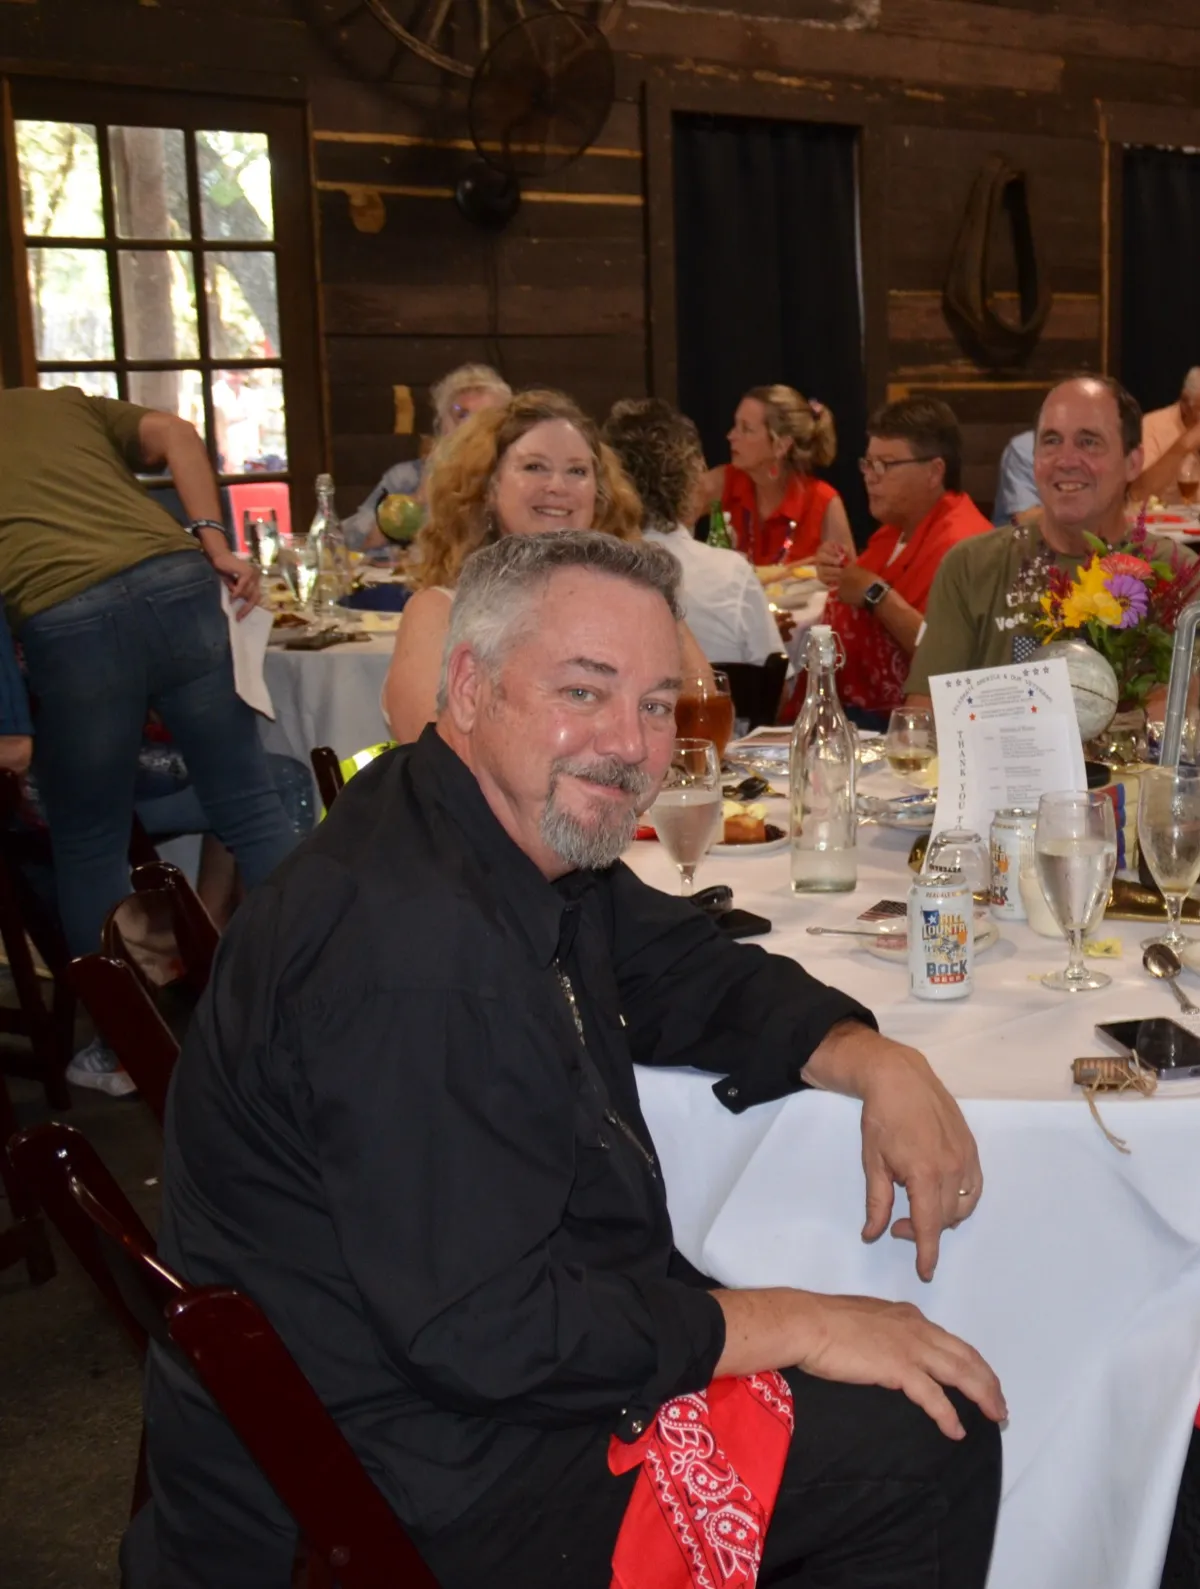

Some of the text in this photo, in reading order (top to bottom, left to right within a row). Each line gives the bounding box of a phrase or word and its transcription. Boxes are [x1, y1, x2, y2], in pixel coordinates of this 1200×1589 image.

[976, 673, 1000, 686] AMERICA
[1010, 674, 1022, 682] OUR
[956, 730, 967, 777] THANK
[958, 783, 967, 811] YOU
[926, 960, 968, 978] BOCK
